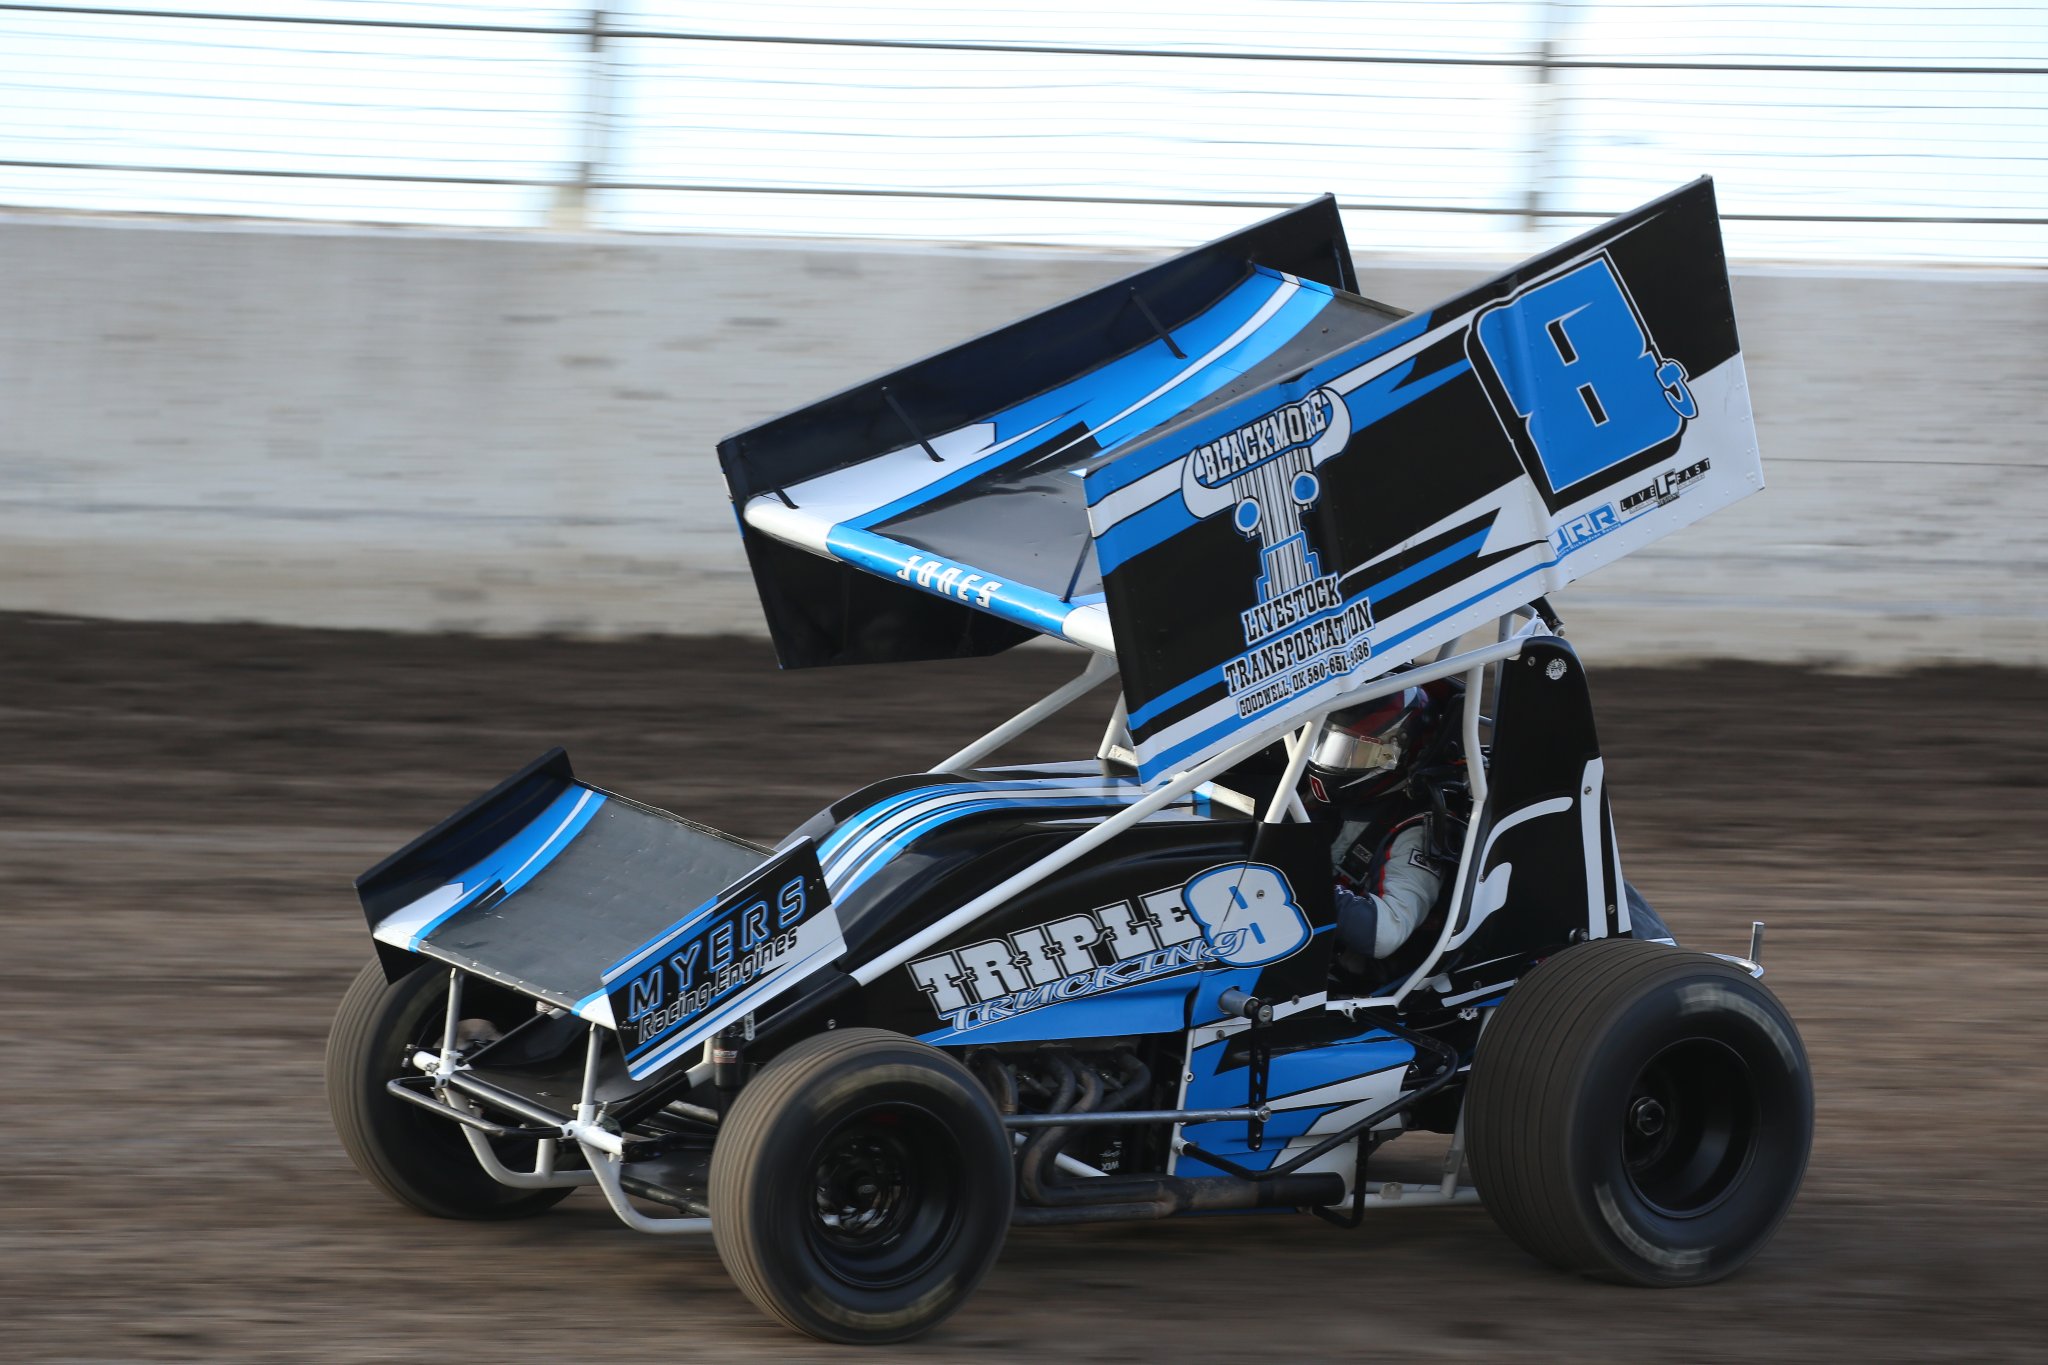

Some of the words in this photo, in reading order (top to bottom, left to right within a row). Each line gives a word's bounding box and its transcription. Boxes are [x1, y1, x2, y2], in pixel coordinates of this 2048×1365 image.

[1200, 393, 1327, 484] BLACKMORE
[1621, 486, 1656, 511] LIVE
[1675, 459, 1710, 485] FAST
[896, 554, 1004, 609] JONES
[1243, 576, 1342, 642] LIVESTOCK
[1225, 599, 1373, 693] TRANSPORTATION
[627, 875, 807, 1023] MYERS
[907, 883, 1203, 1014] TRIPLE
[1181, 861, 1313, 969] 8
